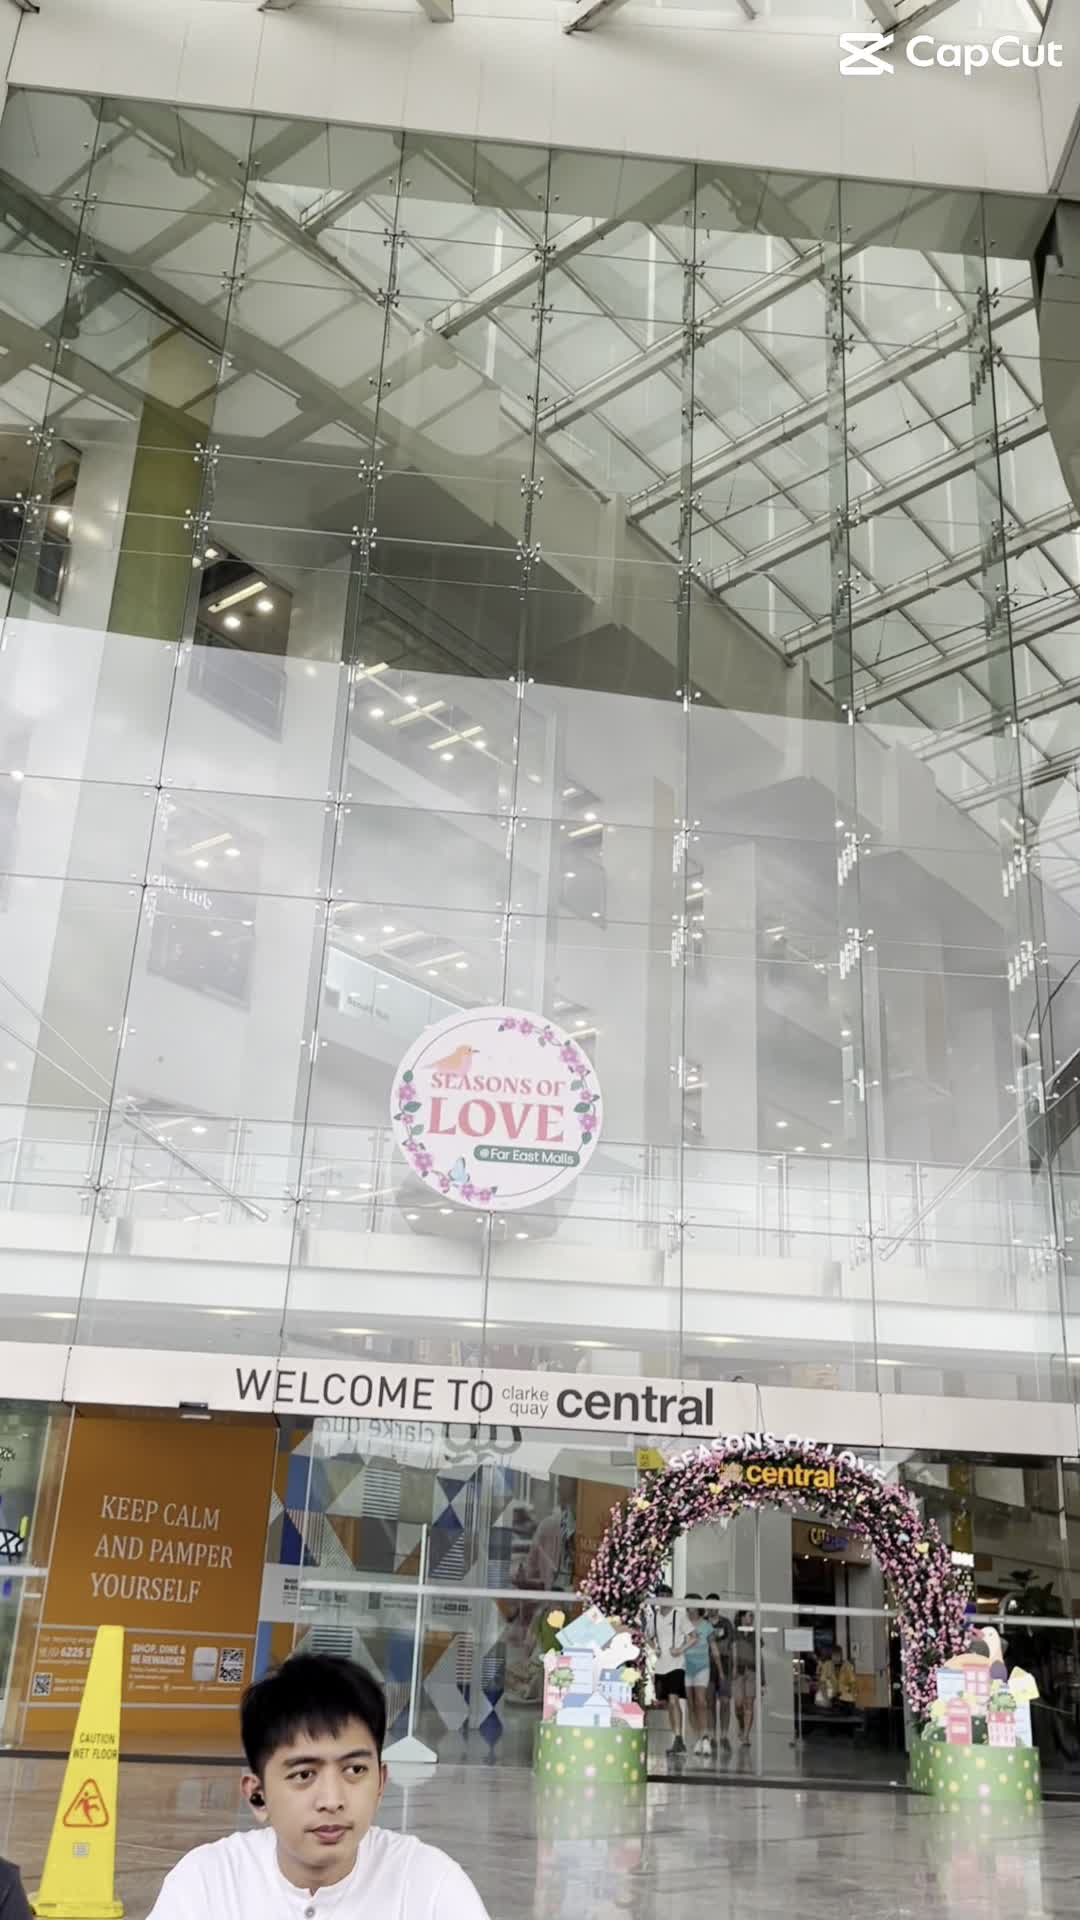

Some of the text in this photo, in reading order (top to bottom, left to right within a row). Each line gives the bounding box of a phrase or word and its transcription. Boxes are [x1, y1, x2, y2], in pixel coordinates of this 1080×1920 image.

[431, 1071, 566, 1097] SEASONS OF
[427, 1097, 565, 1143] LOVE
[512, 1150, 541, 1162] East
[542, 1152, 575, 1165] Malls
[236, 1368, 493, 1413] WELCOME TO
[502, 1386, 550, 1402] clarke
[510, 1401, 549, 1422] quay
[556, 1386, 714, 1426] central
[746, 1463, 836, 1489] central
[100, 1495, 221, 1531] KEEP CALM
[94, 1534, 233, 1569] AND PAMPER
[90, 1572, 201, 1604] YOURSELF
[80, 1731, 115, 1745] CAUTION
[92, 1748, 117, 1760] FLOOR
